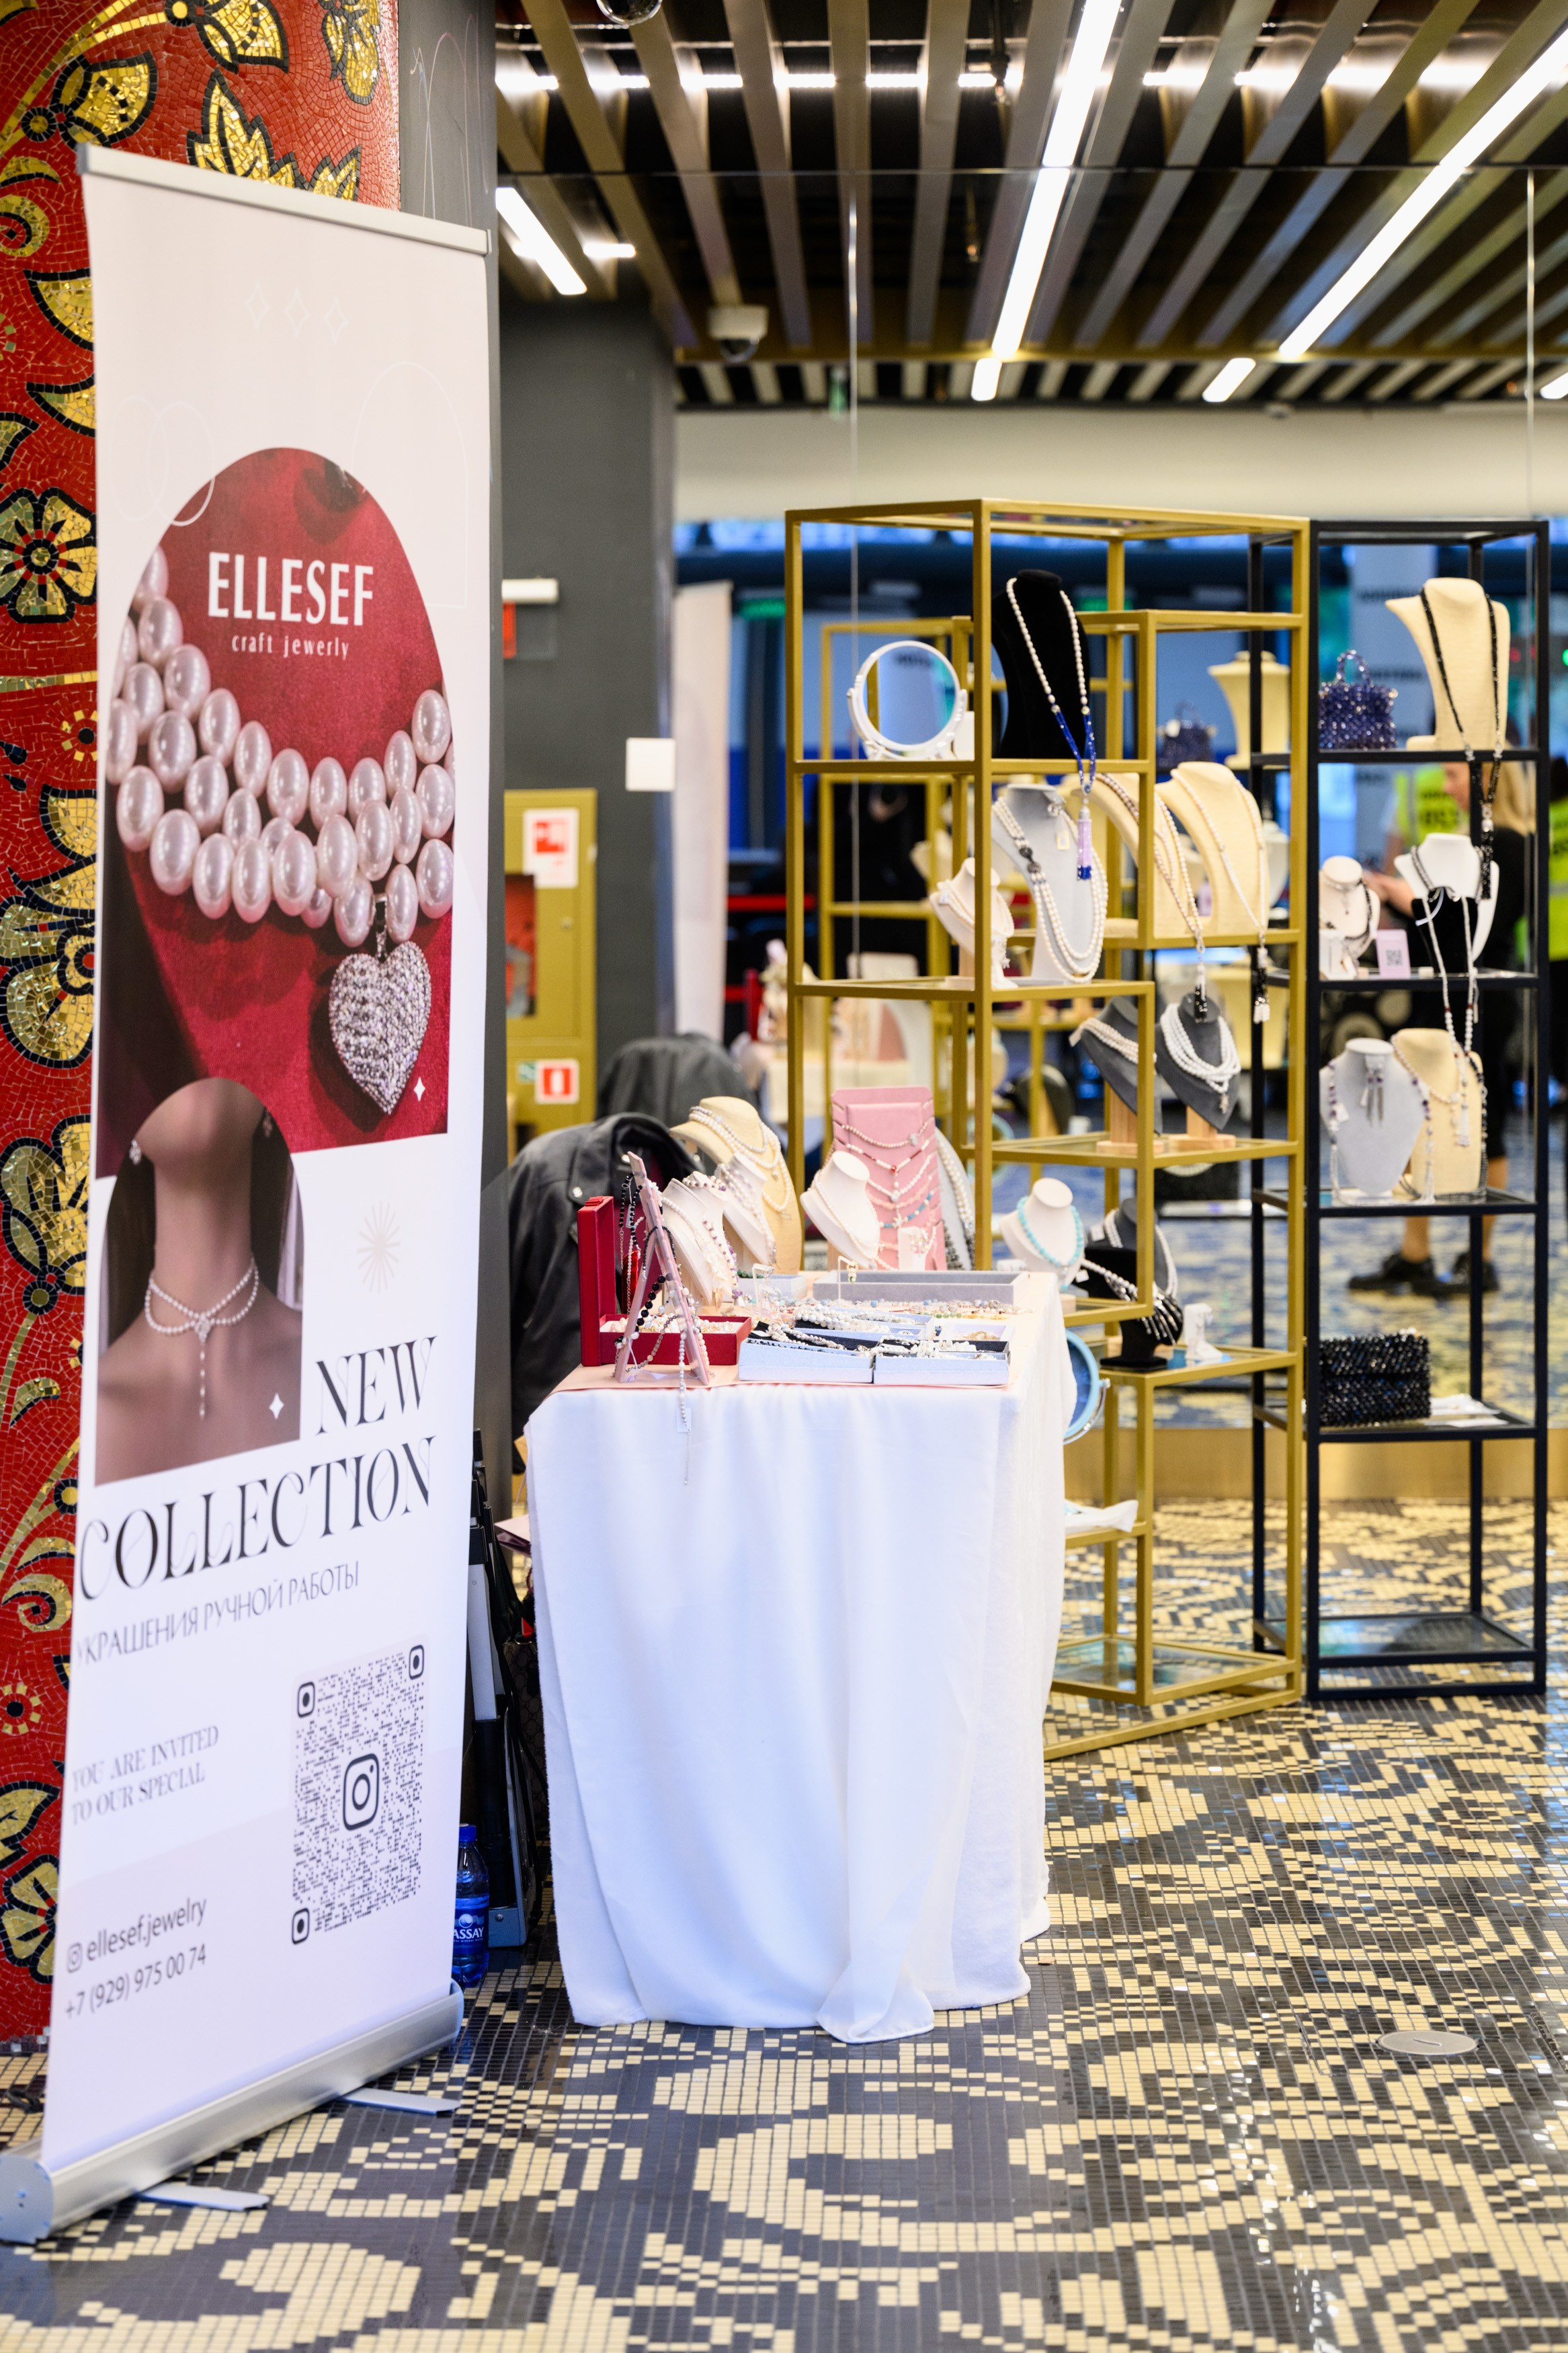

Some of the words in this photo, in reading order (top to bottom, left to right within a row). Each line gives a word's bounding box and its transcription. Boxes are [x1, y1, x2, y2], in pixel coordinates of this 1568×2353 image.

[208, 551, 374, 626] ELLESEF
[232, 632, 273, 653] craft
[283, 635, 349, 661] jewerly
[315, 1335, 438, 1436] NEW
[79, 1436, 437, 1600] COLLECTION
[76, 1607, 198, 1668] УКРАШЕНИЯ
[204, 1579, 284, 1627] РУЧНОЙ
[288, 1560, 359, 1606] РАБОТЫ
[71, 1760, 104, 1793] YOU
[110, 1748, 147, 1780] ARE
[151, 1725, 219, 1765] INVITED
[71, 1798, 93, 1825] TO
[95, 1785, 135, 1817] OUR
[138, 1761, 206, 1802] SPECIAL
[87, 1897, 207, 1962] ellesef.jewelry
[454, 1927, 484, 1940] ASSAY
[65, 1991, 85, 2018] +7
[89, 1971, 130, 2013] (929)
[134, 1960, 162, 1992] 975
[166, 1952, 185, 1979] 00
[188, 1944, 207, 1970] 74
